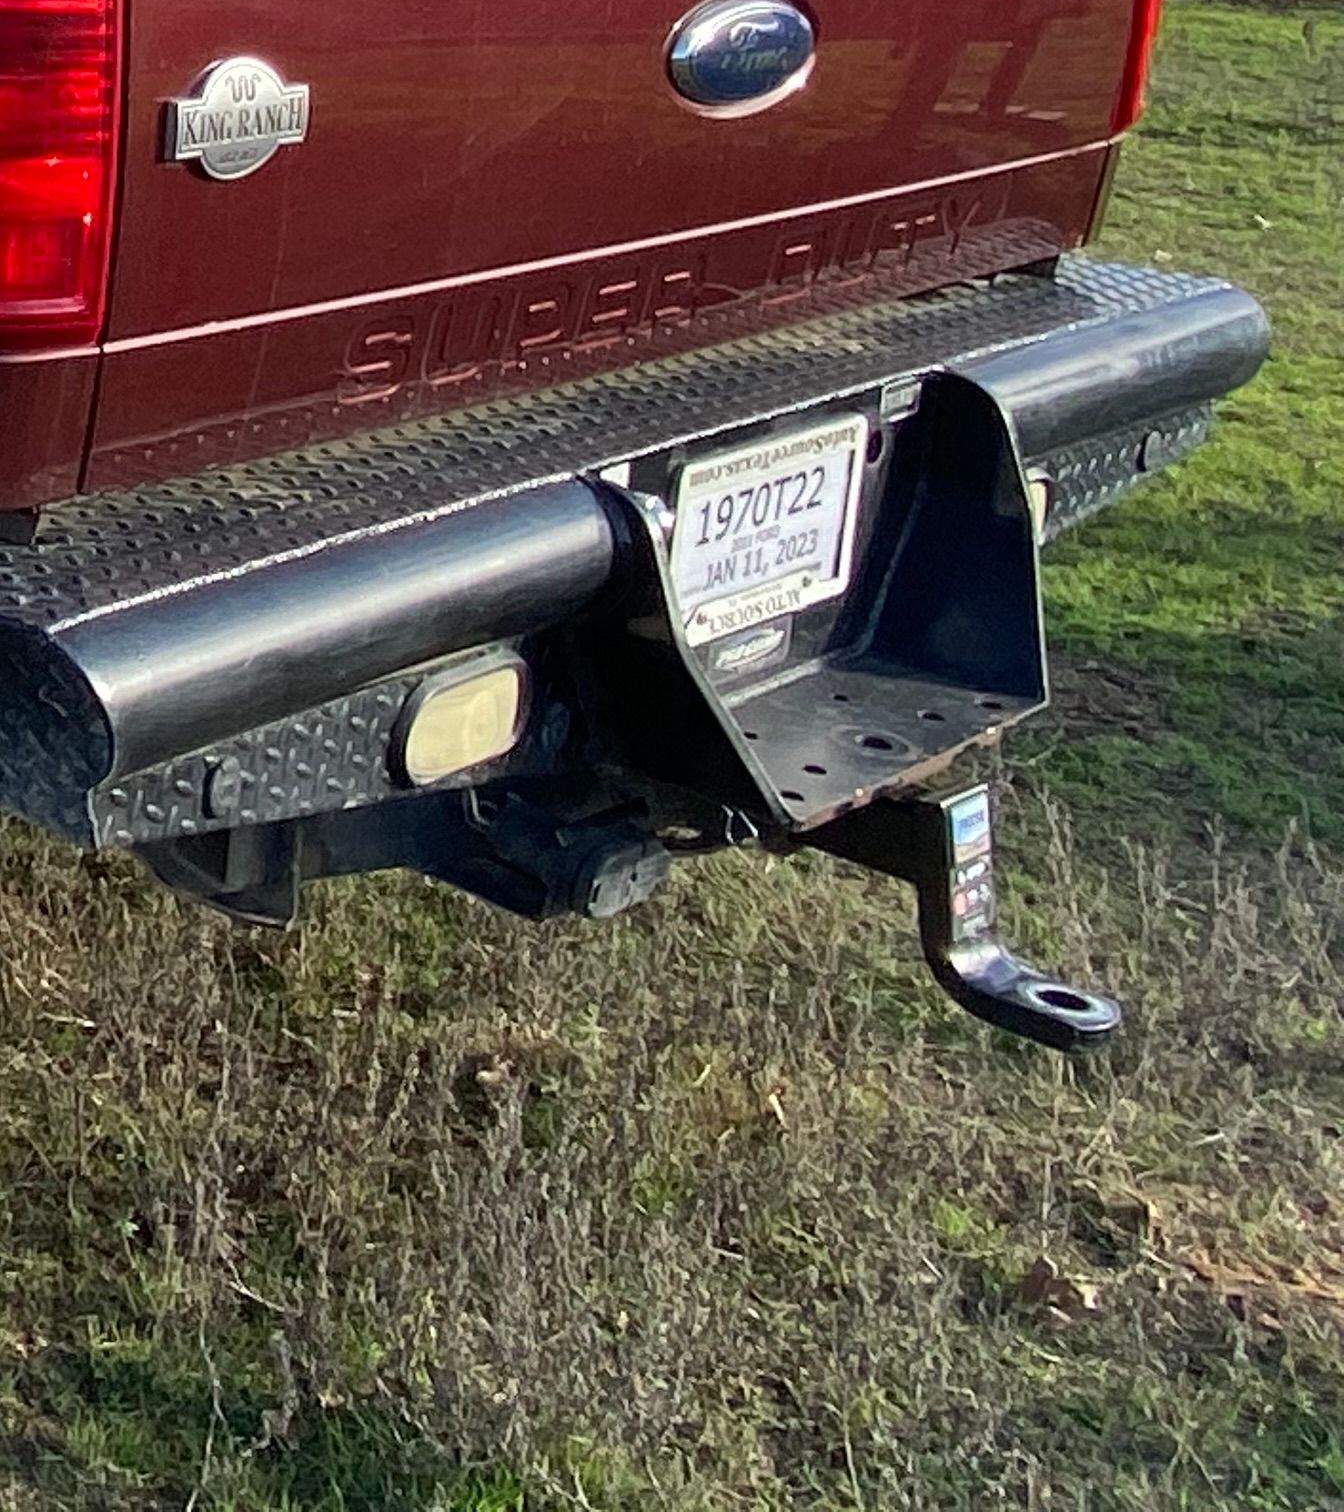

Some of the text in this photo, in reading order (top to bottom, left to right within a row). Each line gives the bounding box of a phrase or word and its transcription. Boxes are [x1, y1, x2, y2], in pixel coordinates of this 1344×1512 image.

[183, 97, 303, 145] KING RANCH
[337, 255, 708, 405] SUPER
[696, 465, 826, 548] 1970T22
[703, 528, 820, 590] JAN 11, 2023
[765, 589, 802, 615] AUTO
